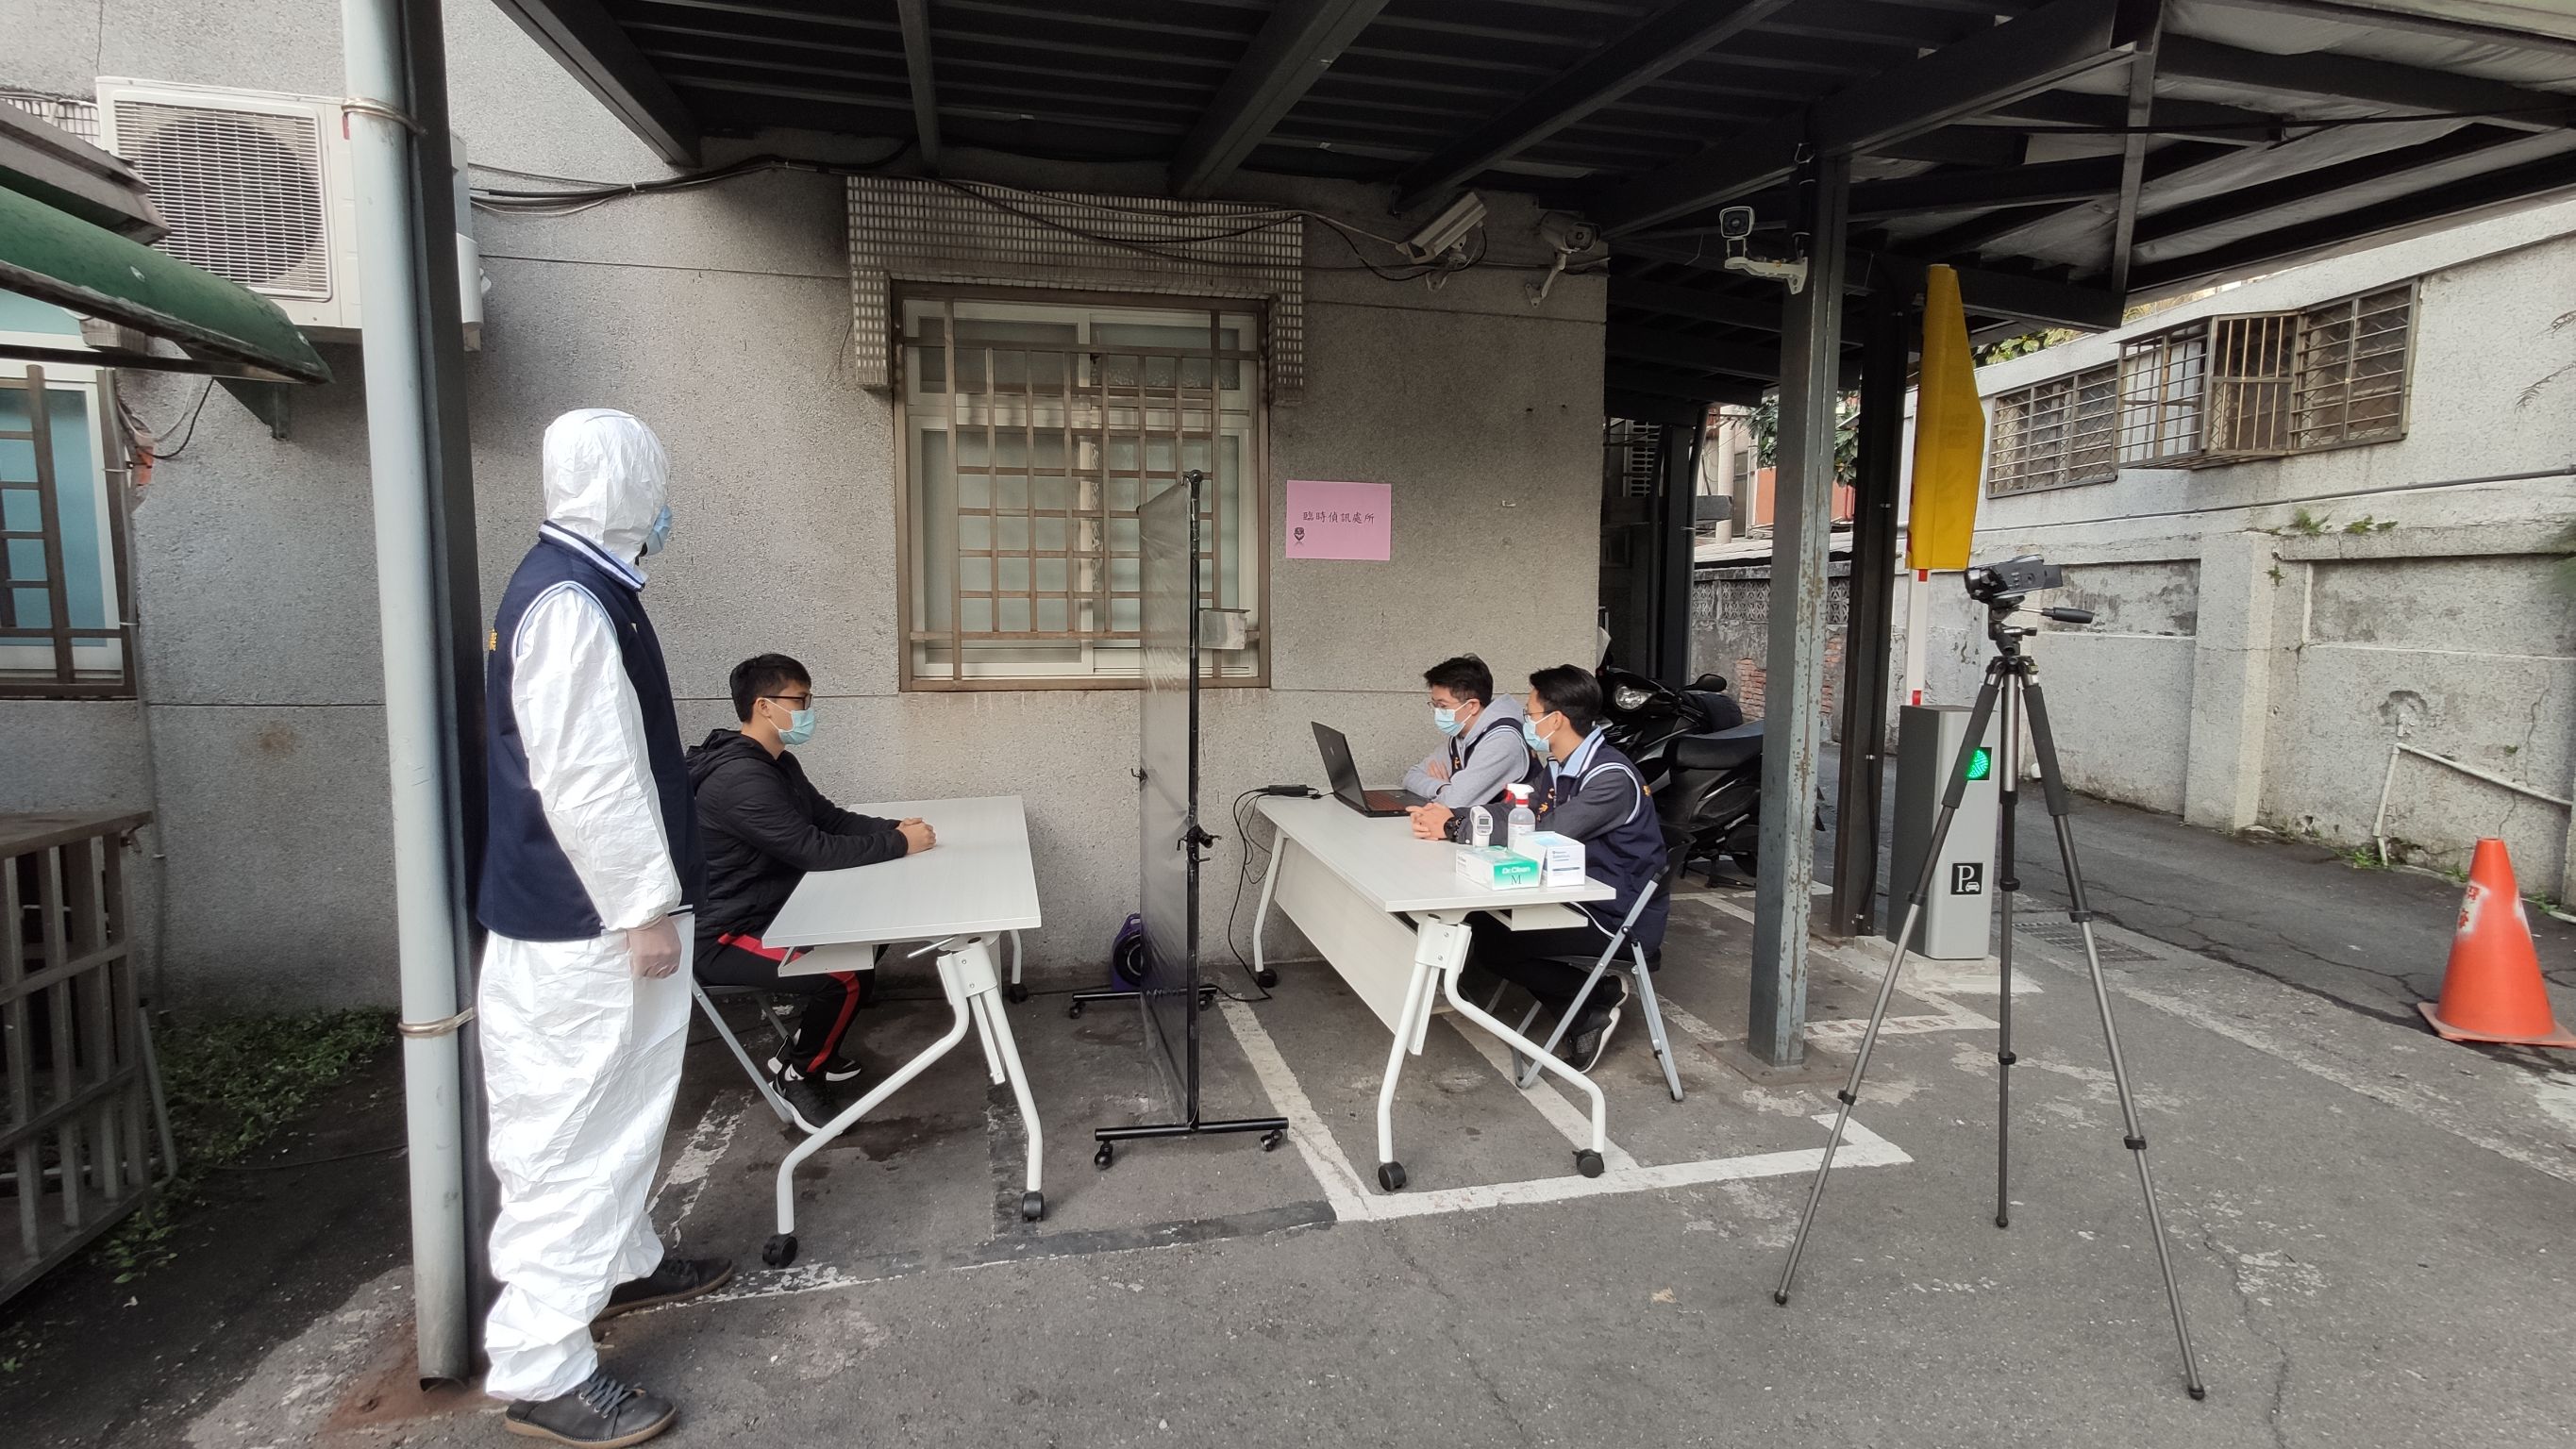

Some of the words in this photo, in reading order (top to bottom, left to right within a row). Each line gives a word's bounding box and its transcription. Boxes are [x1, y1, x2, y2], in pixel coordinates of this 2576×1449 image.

[1303, 510, 1375, 525] 臨時偵訊處所
[1511, 874, 1522, 885] M
[1956, 865, 1975, 892] P
